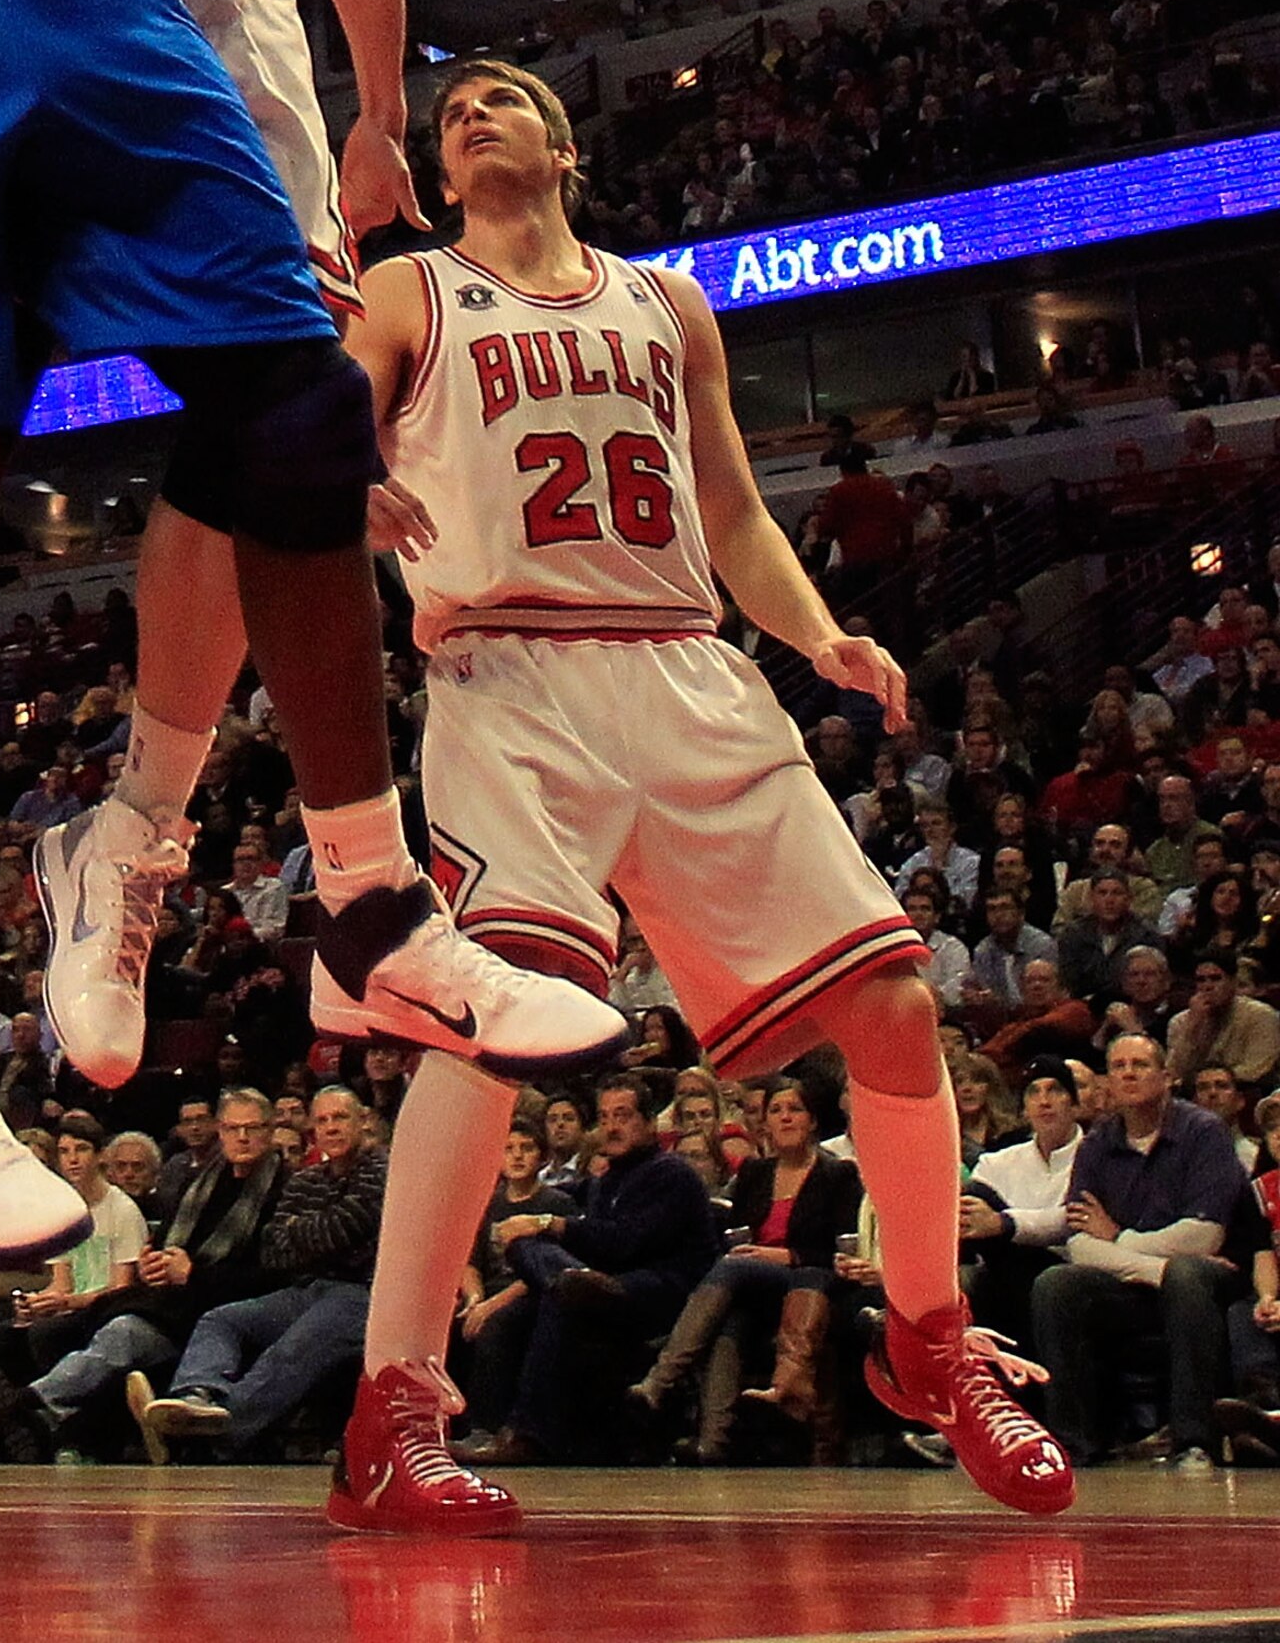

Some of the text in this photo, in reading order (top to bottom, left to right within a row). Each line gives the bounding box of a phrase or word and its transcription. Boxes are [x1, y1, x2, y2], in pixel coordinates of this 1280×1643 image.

[730, 221, 945, 300] Abt.com
[469, 329, 677, 436] BULLS
[515, 431, 677, 550] 26
